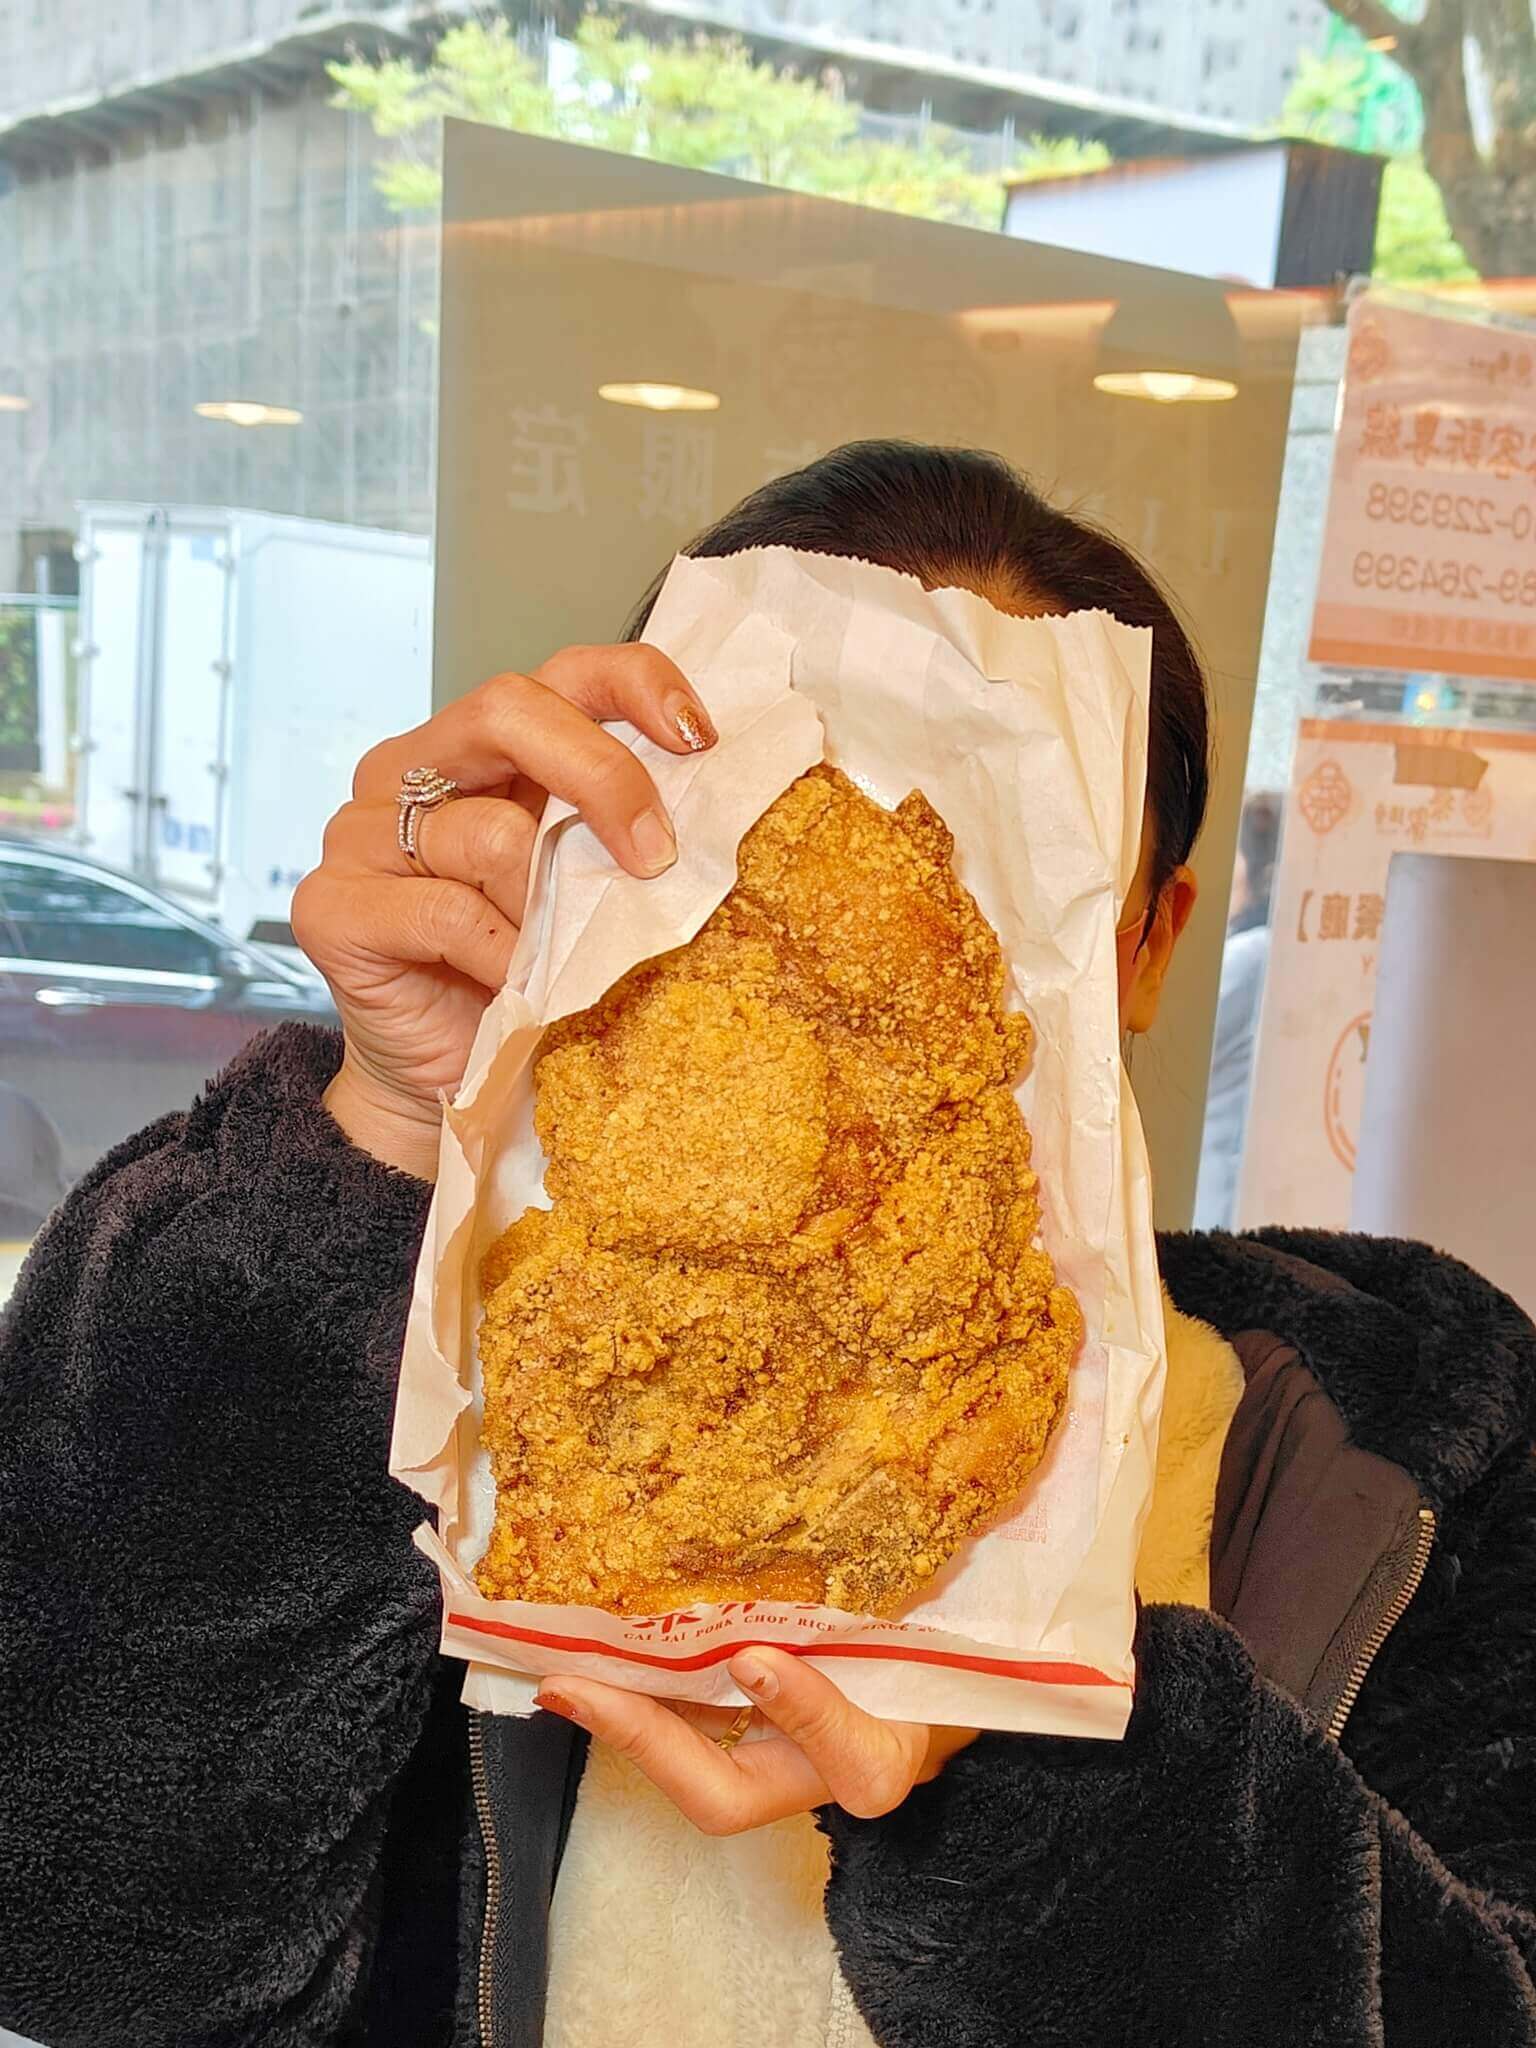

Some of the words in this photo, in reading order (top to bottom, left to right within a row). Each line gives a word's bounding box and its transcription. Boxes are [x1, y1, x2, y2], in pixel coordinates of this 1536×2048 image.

[661, 1631, 687, 1643] JAI
[694, 1616, 734, 1638] PORK
[743, 1614, 789, 1625] CHOP
[797, 1617, 837, 1632] RICE
